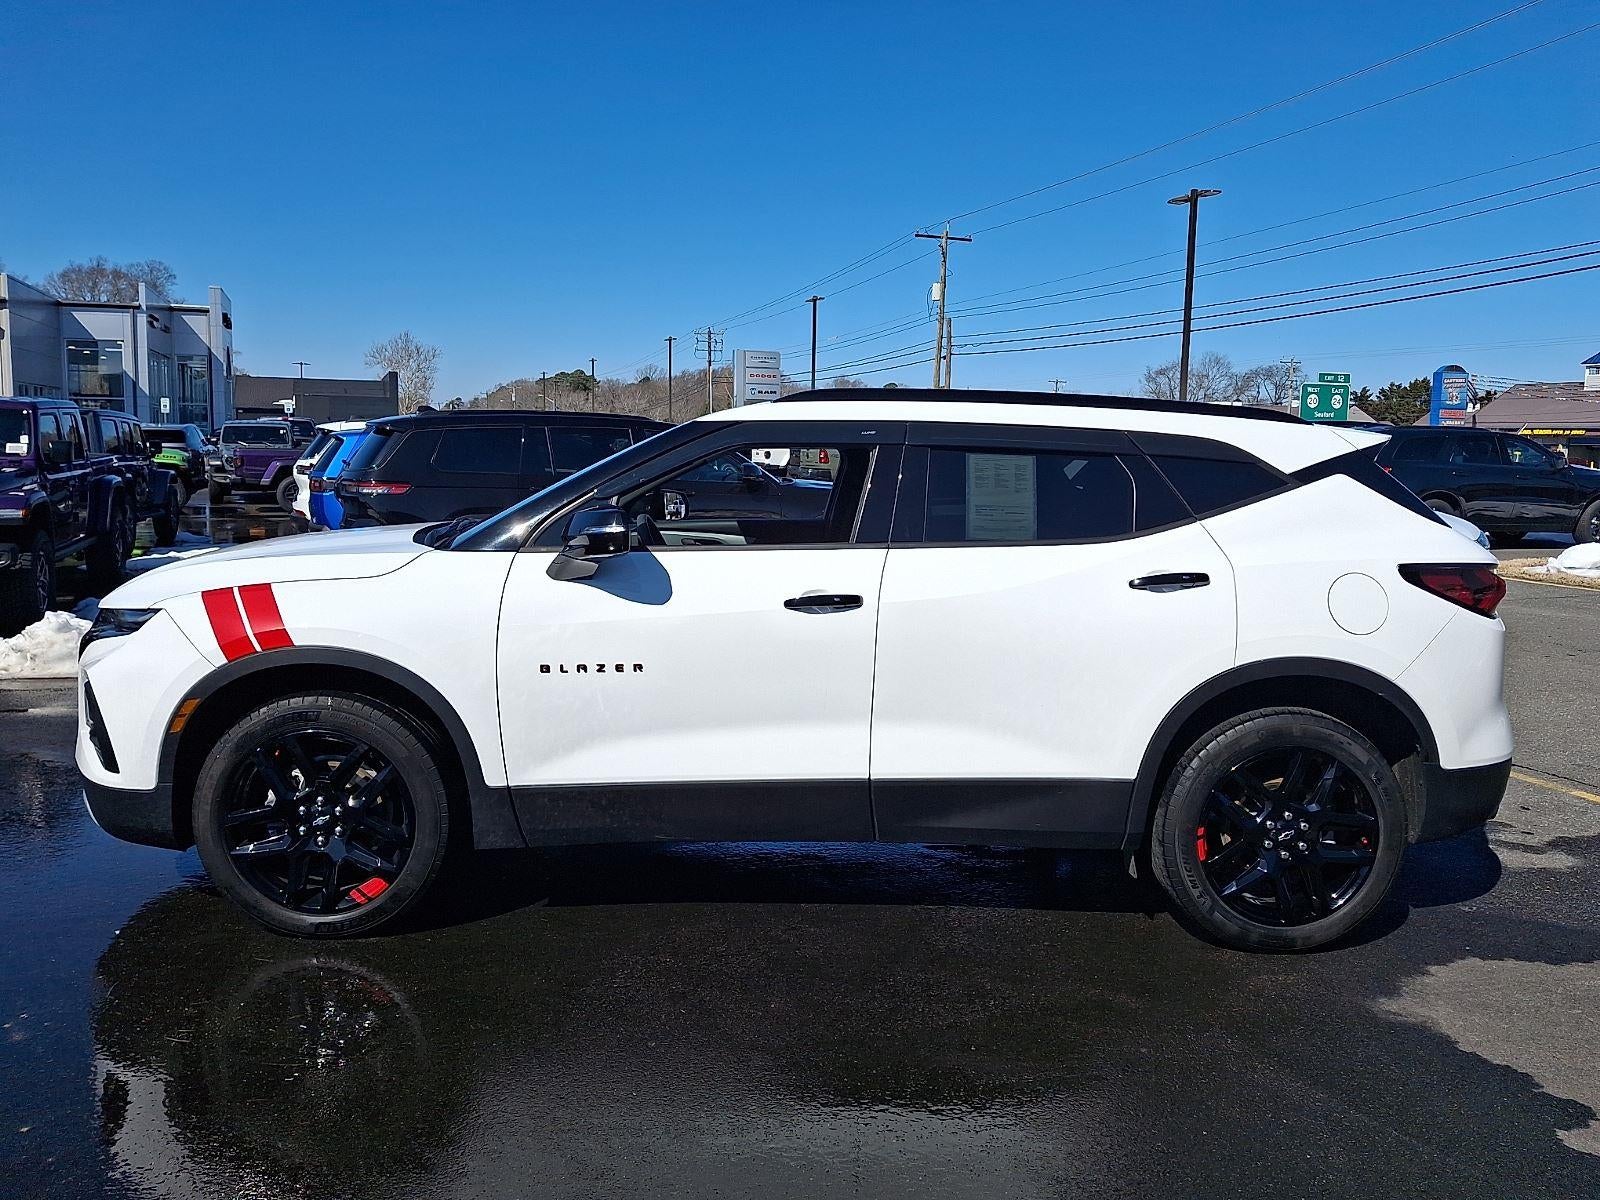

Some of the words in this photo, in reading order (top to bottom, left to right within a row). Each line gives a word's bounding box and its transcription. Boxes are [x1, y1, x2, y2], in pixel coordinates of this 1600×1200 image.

[1308, 397, 1318, 405] 20
[1332, 397, 1341, 405] 24
[540, 663, 643, 674] BLAZER
